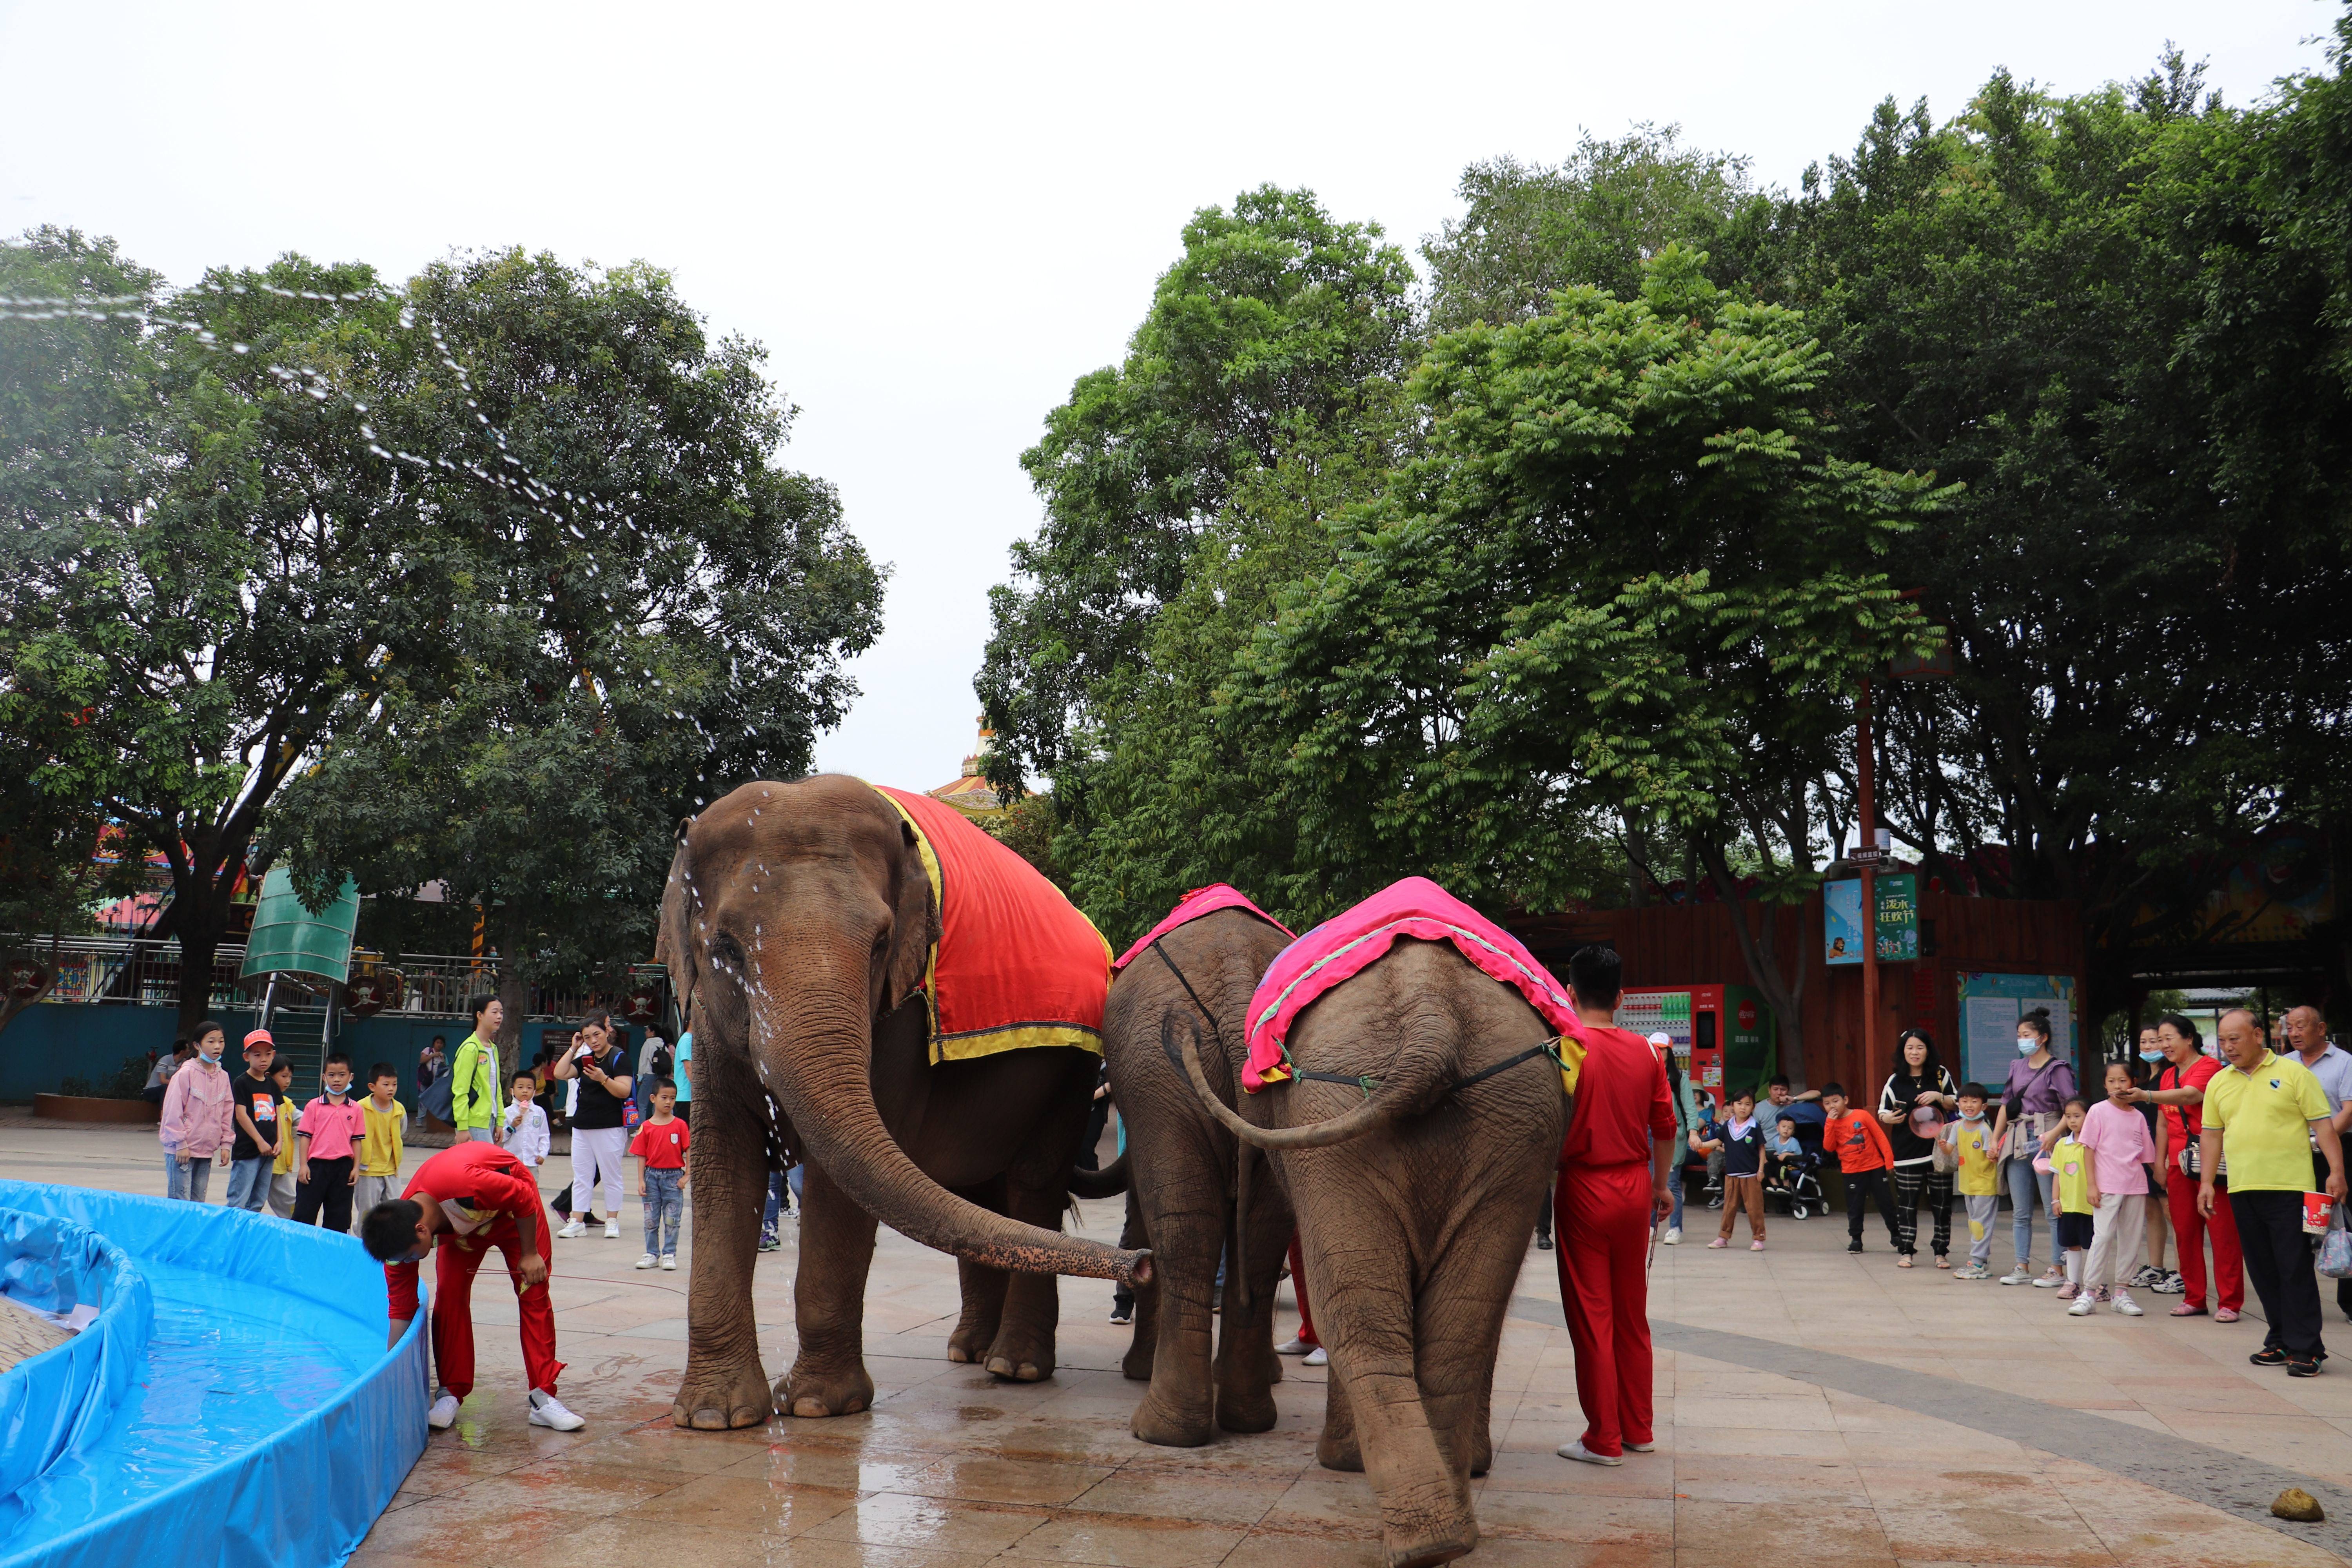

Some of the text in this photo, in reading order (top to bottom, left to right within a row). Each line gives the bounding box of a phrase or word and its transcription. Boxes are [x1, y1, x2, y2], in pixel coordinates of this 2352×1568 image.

[1886, 899, 1908, 909] 泼水
[1880, 909, 1914, 924] 狂欢节
